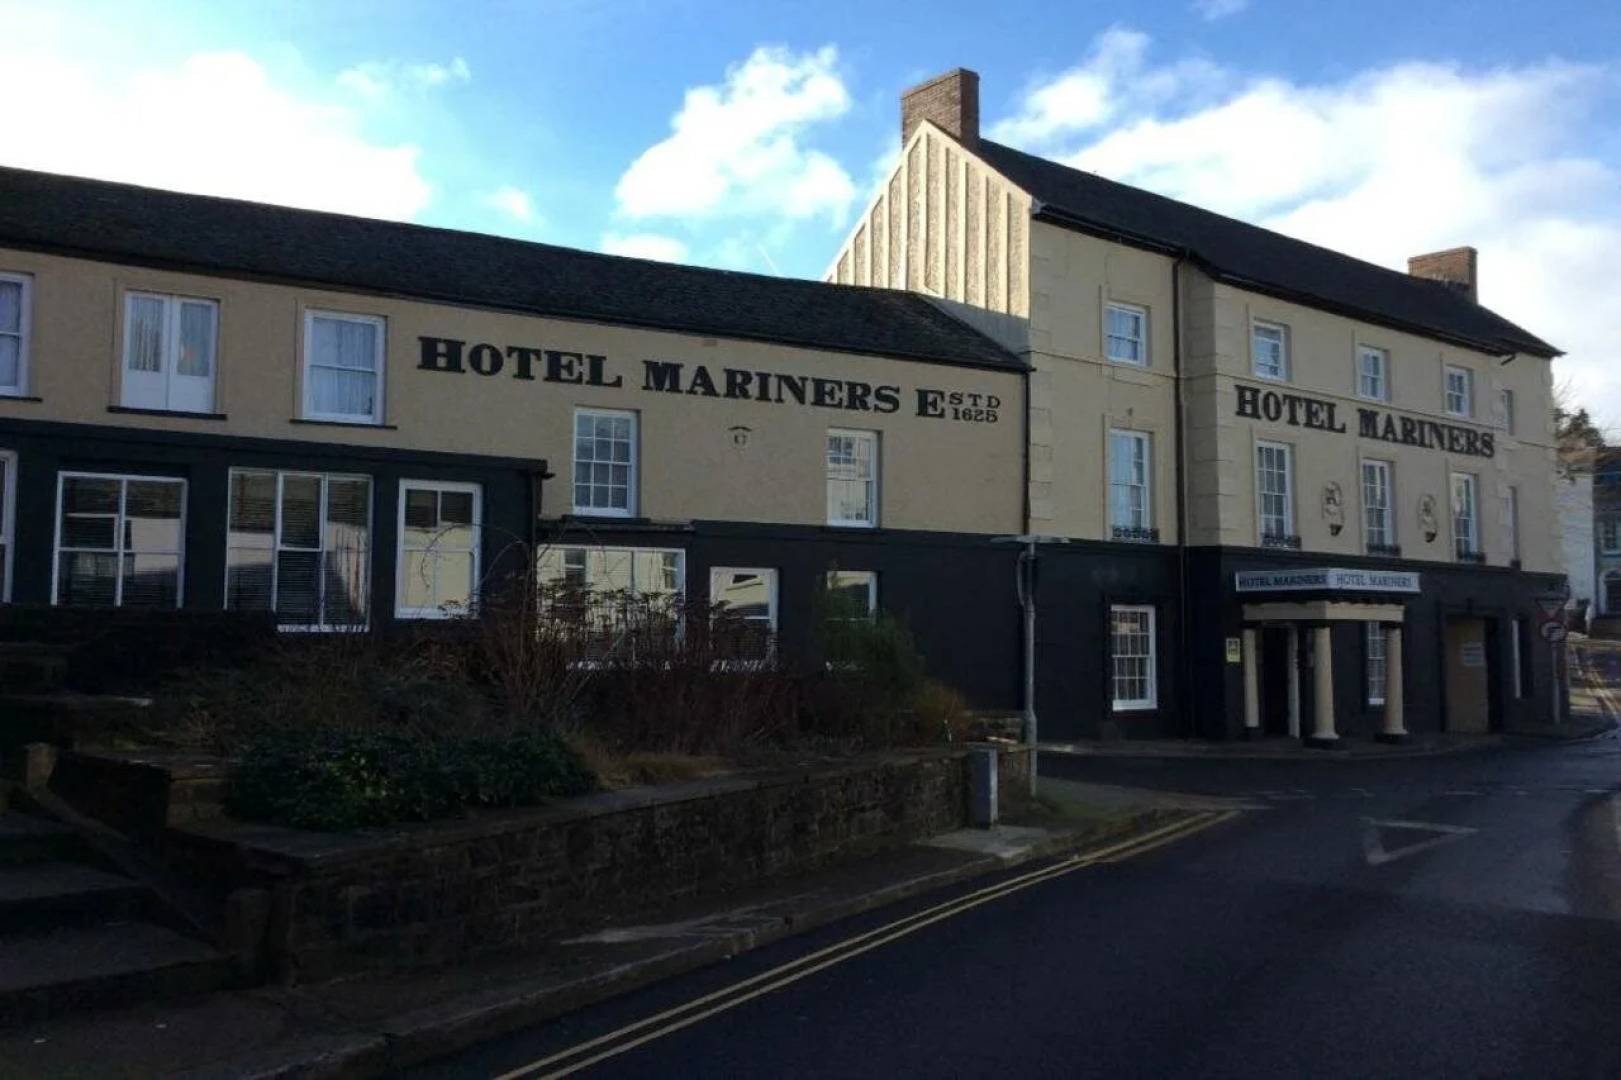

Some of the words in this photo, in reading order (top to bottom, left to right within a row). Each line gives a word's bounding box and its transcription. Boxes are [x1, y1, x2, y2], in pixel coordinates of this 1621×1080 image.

[417, 336, 622, 388] HOTEL
[640, 359, 900, 413] MARINERS
[916, 389, 1000, 418] ESTD
[1234, 384, 1347, 433] HOTEL
[1357, 407, 1495, 458] MARINERS
